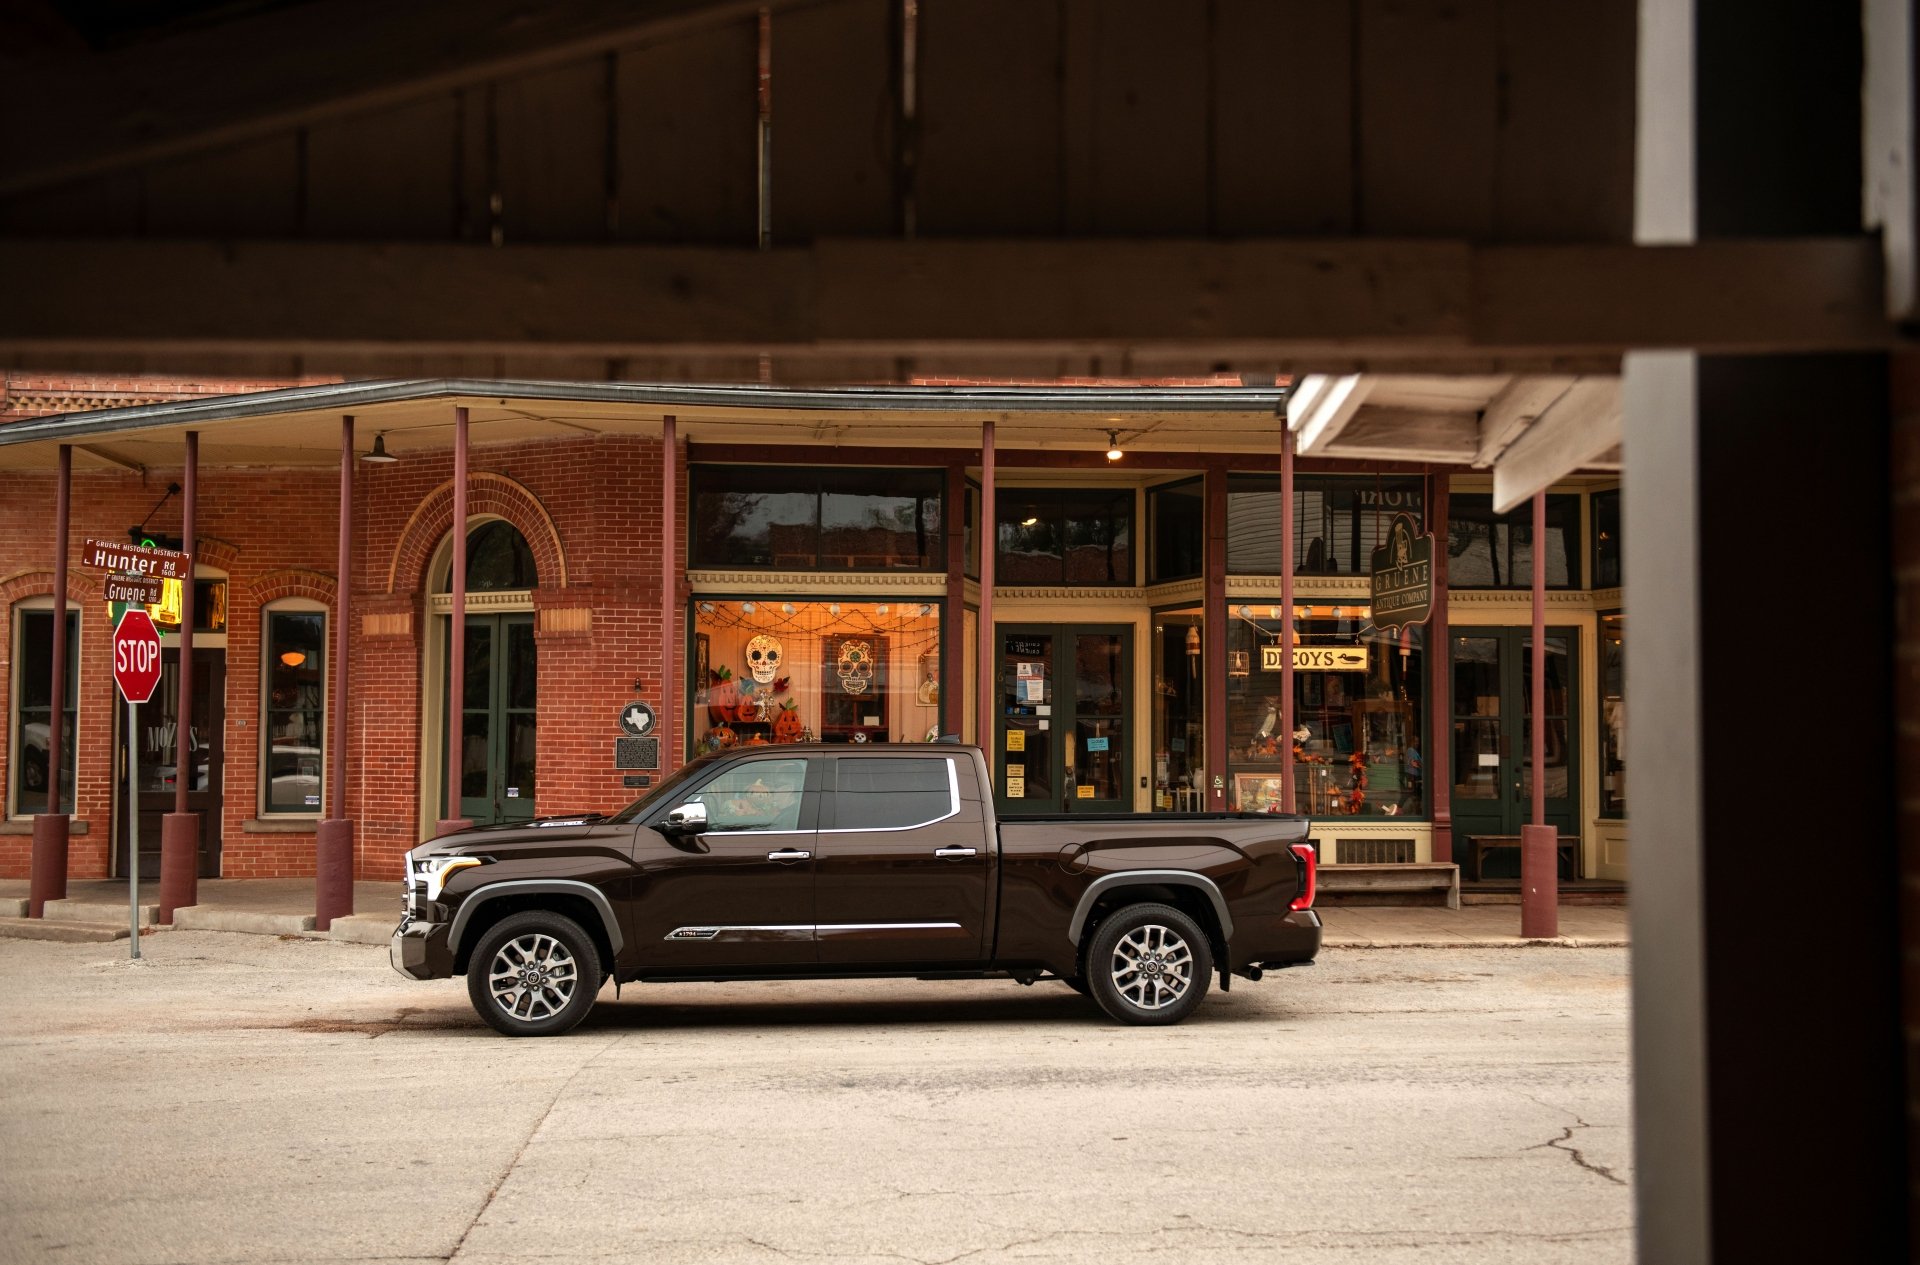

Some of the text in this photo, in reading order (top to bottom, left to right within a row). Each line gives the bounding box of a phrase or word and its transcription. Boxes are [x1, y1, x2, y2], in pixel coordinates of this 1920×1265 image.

[96, 540, 180, 558] GRUENE HISTORIC DISTRICT
[94, 550, 176, 574] Hunter Rd
[161, 569, 176, 577] 1600
[1375, 565, 1428, 591] GRUENE
[109, 583, 158, 602] Gruene Rd
[1375, 590, 1428, 609] ANTIQUE COMPANY
[117, 639, 158, 673] STOP
[147, 722, 199, 752] MOZS
